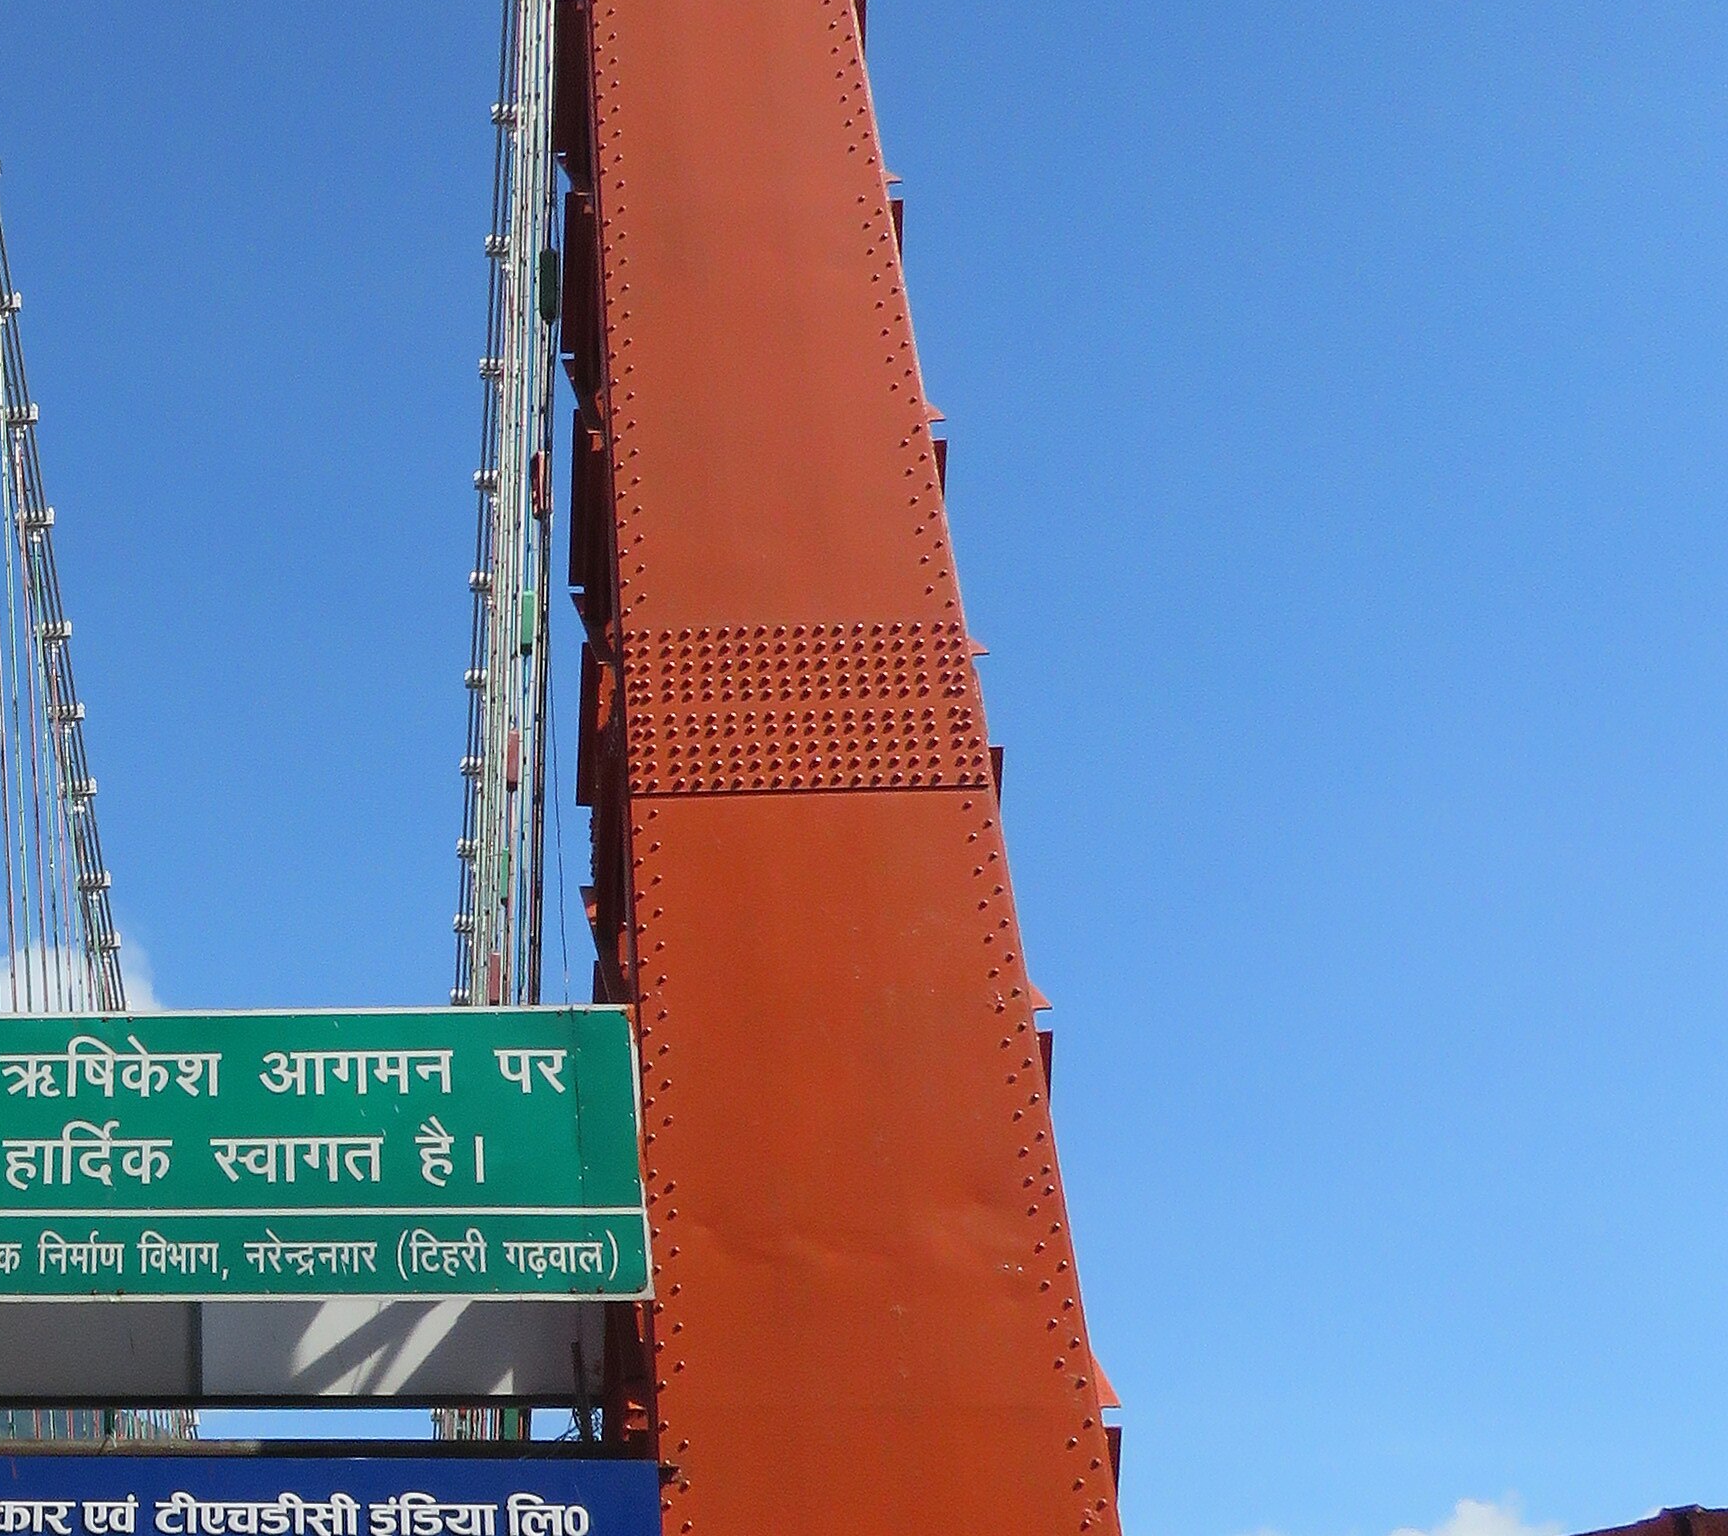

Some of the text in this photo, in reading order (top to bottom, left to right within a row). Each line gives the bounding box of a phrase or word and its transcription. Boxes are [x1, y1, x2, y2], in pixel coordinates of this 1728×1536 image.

[259, 1049, 454, 1096] आगमन
[494, 1048, 567, 1094] पर
[2, 1120, 173, 1191] हार्दिक
[210, 1136, 384, 1183] स्वागत
[37, 1230, 125, 1276] निर्माण
[138, 1230, 229, 1280] विभाग,
[244, 1229, 378, 1276] नरेन्द्रनगर
[396, 1228, 488, 1281] (टिहरी
[503, 1229, 619, 1281] गढ़वाल)
[82, 1494, 139, 1534] एवं
[154, 1492, 361, 1536] टीएचडीसी
